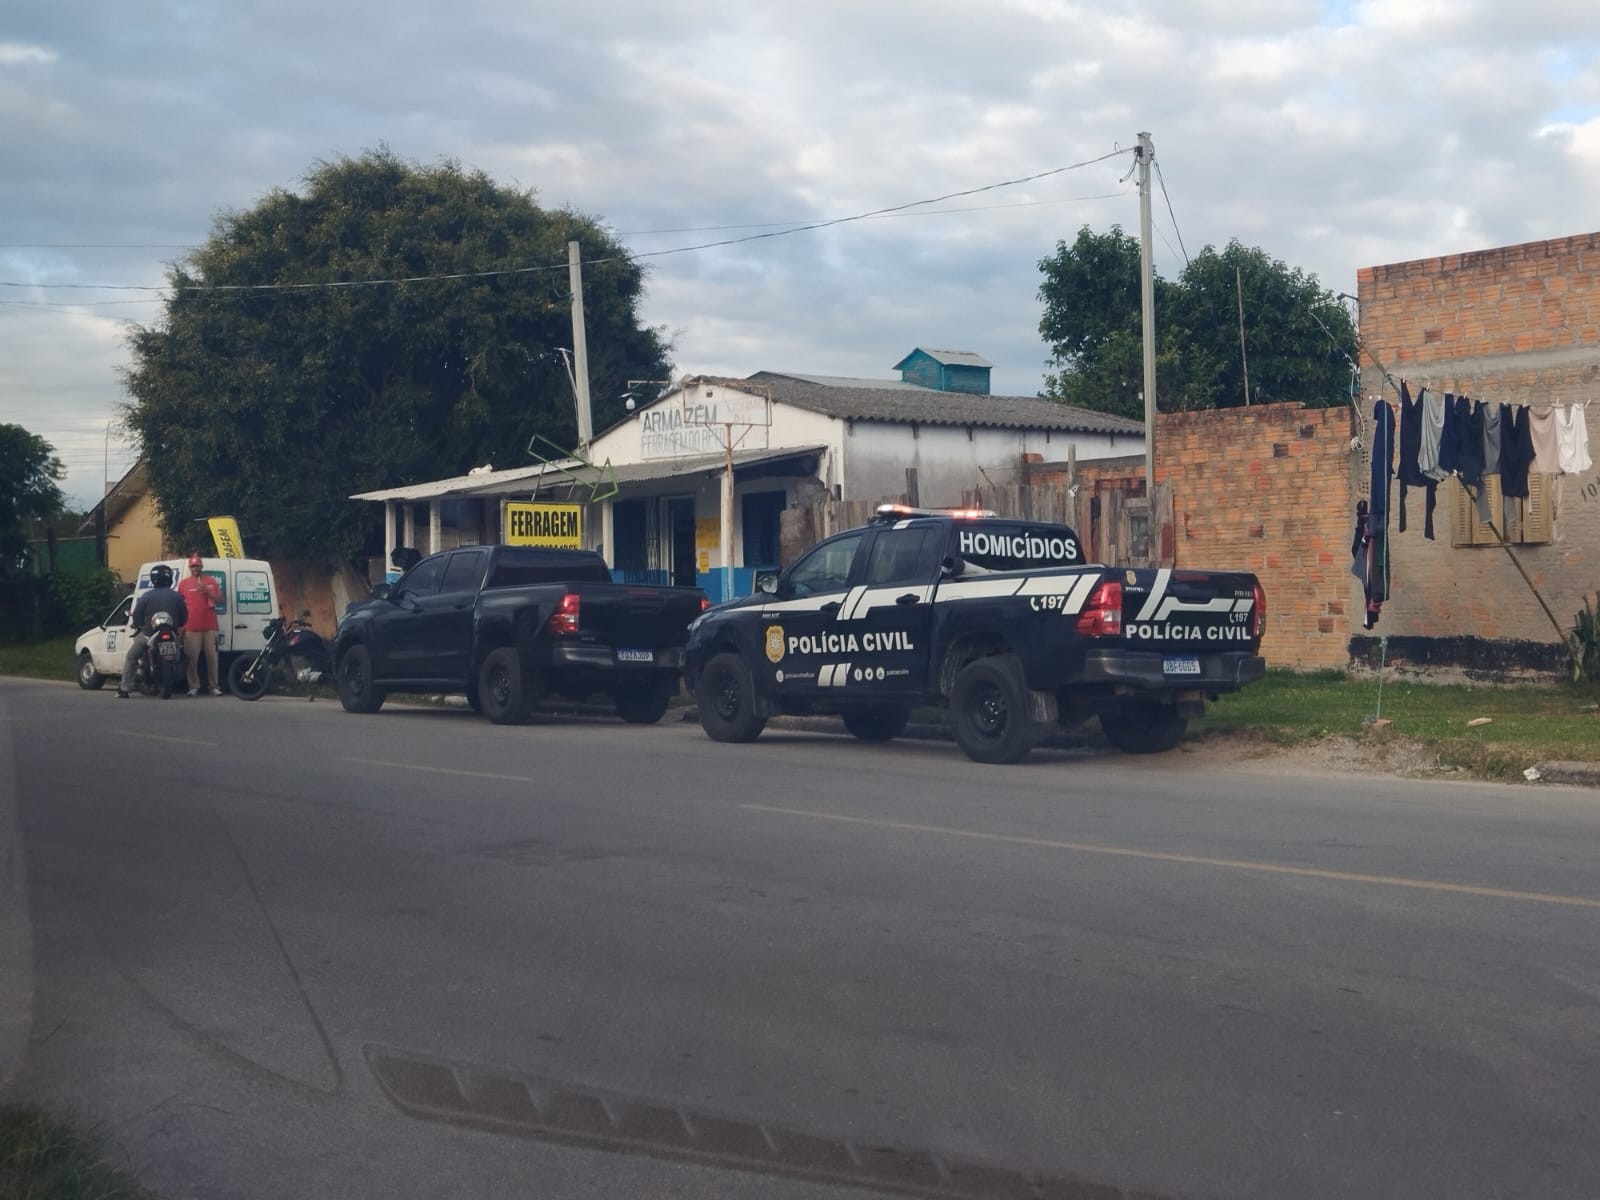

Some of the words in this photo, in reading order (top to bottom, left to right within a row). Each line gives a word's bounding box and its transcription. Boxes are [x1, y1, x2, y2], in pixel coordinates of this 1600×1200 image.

[643, 404, 717, 433] ARMAZÉM
[511, 510, 578, 537] FERRAGEM
[959, 531, 1077, 559] HOMICÍDIOS
[1040, 595, 1065, 609] 197
[1235, 612, 1248, 623] 197
[788, 631, 859, 654] POLÍCIA
[863, 631, 914, 651] CIVIL
[1125, 622, 1202, 640] POLÍCIA
[1206, 626, 1252, 640] CIVIL
